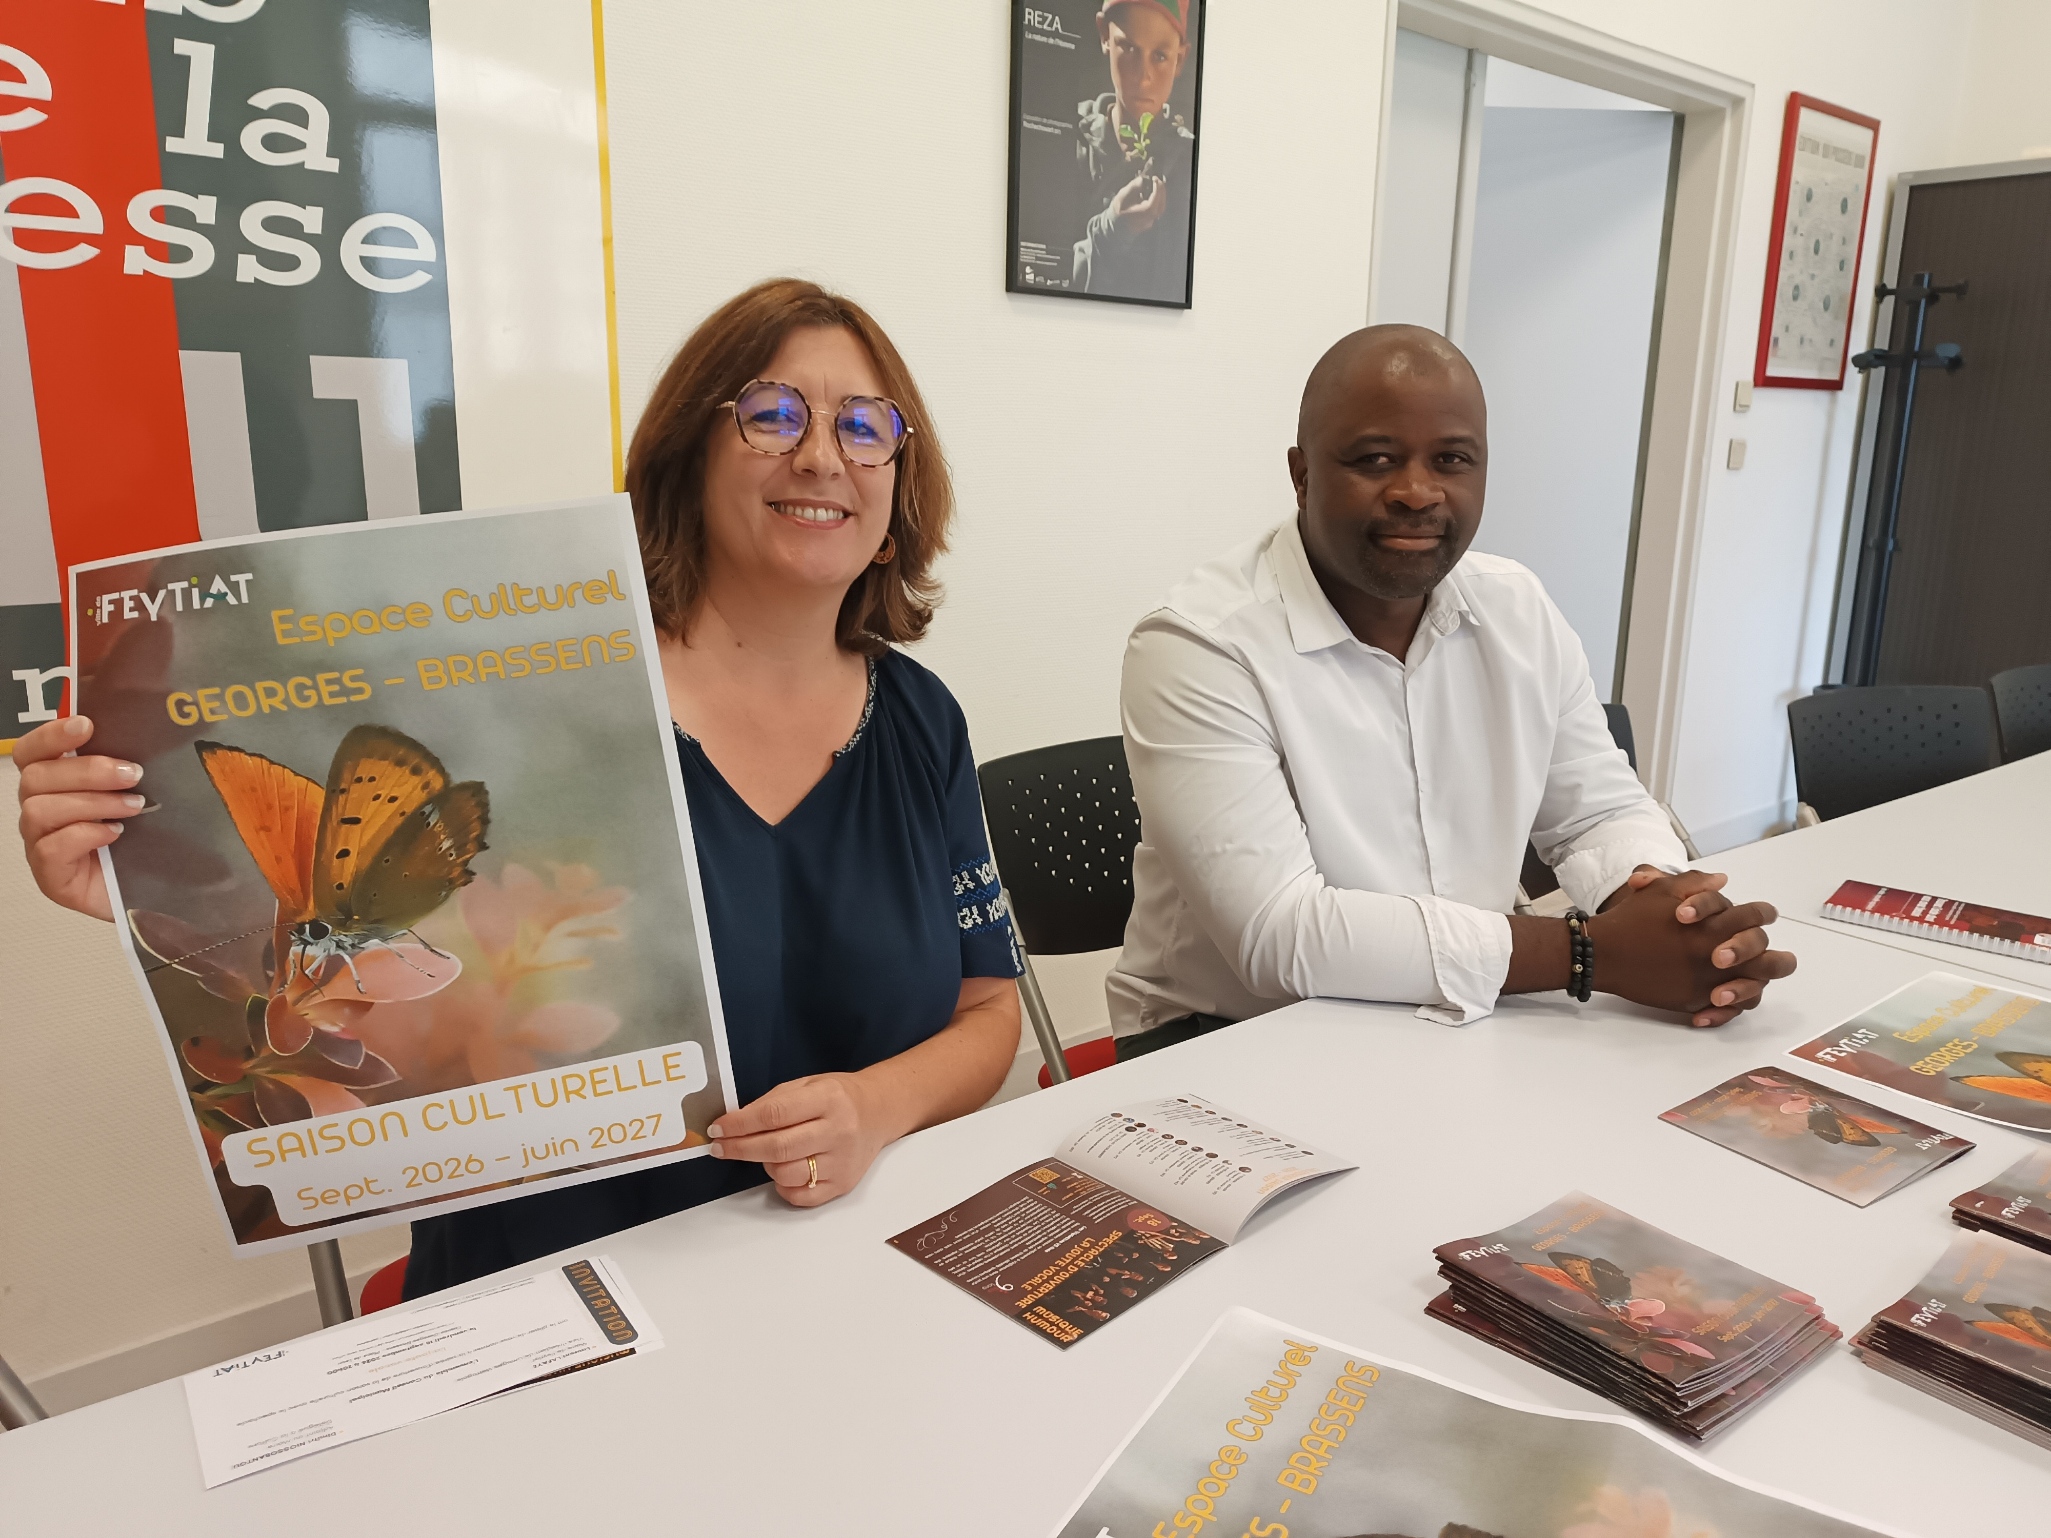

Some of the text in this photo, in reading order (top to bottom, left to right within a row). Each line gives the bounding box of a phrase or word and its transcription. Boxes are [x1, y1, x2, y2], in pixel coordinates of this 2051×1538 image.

[1024, 8, 1062, 33] REZA
[165, 38, 339, 173] la
[271, 570, 625, 647] Espace Culturel
[166, 668, 372, 727] GEORGES
[416, 629, 636, 691] BRASSENS
[1909, 1038, 1979, 1076] GEORGES
[246, 1051, 687, 1168] SAISON CULTURELLE
[296, 1177, 393, 1210] Sept.
[401, 1154, 486, 1189] 2026
[521, 1137, 580, 1168] juin
[588, 1113, 663, 1149] 2027
[1055, 1246, 1084, 1269] JOUTE
[1078, 1230, 1123, 1268] SPECTACLE
[1081, 1237, 1096, 1250] LA
[1015, 1264, 1080, 1308] D'OUVERTURE
[1020, 1266, 1059, 1291] VOCALE
[568, 1261, 633, 1341] INVITATION
[1033, 1305, 1084, 1337] MUSIQUE
[1022, 1312, 1071, 1343] HUMOUR
[1152, 1444, 1248, 1538] Espace
[1225, 1339, 1318, 1442] Culturel
[1276, 1360, 1381, 1495] BRASSENS
